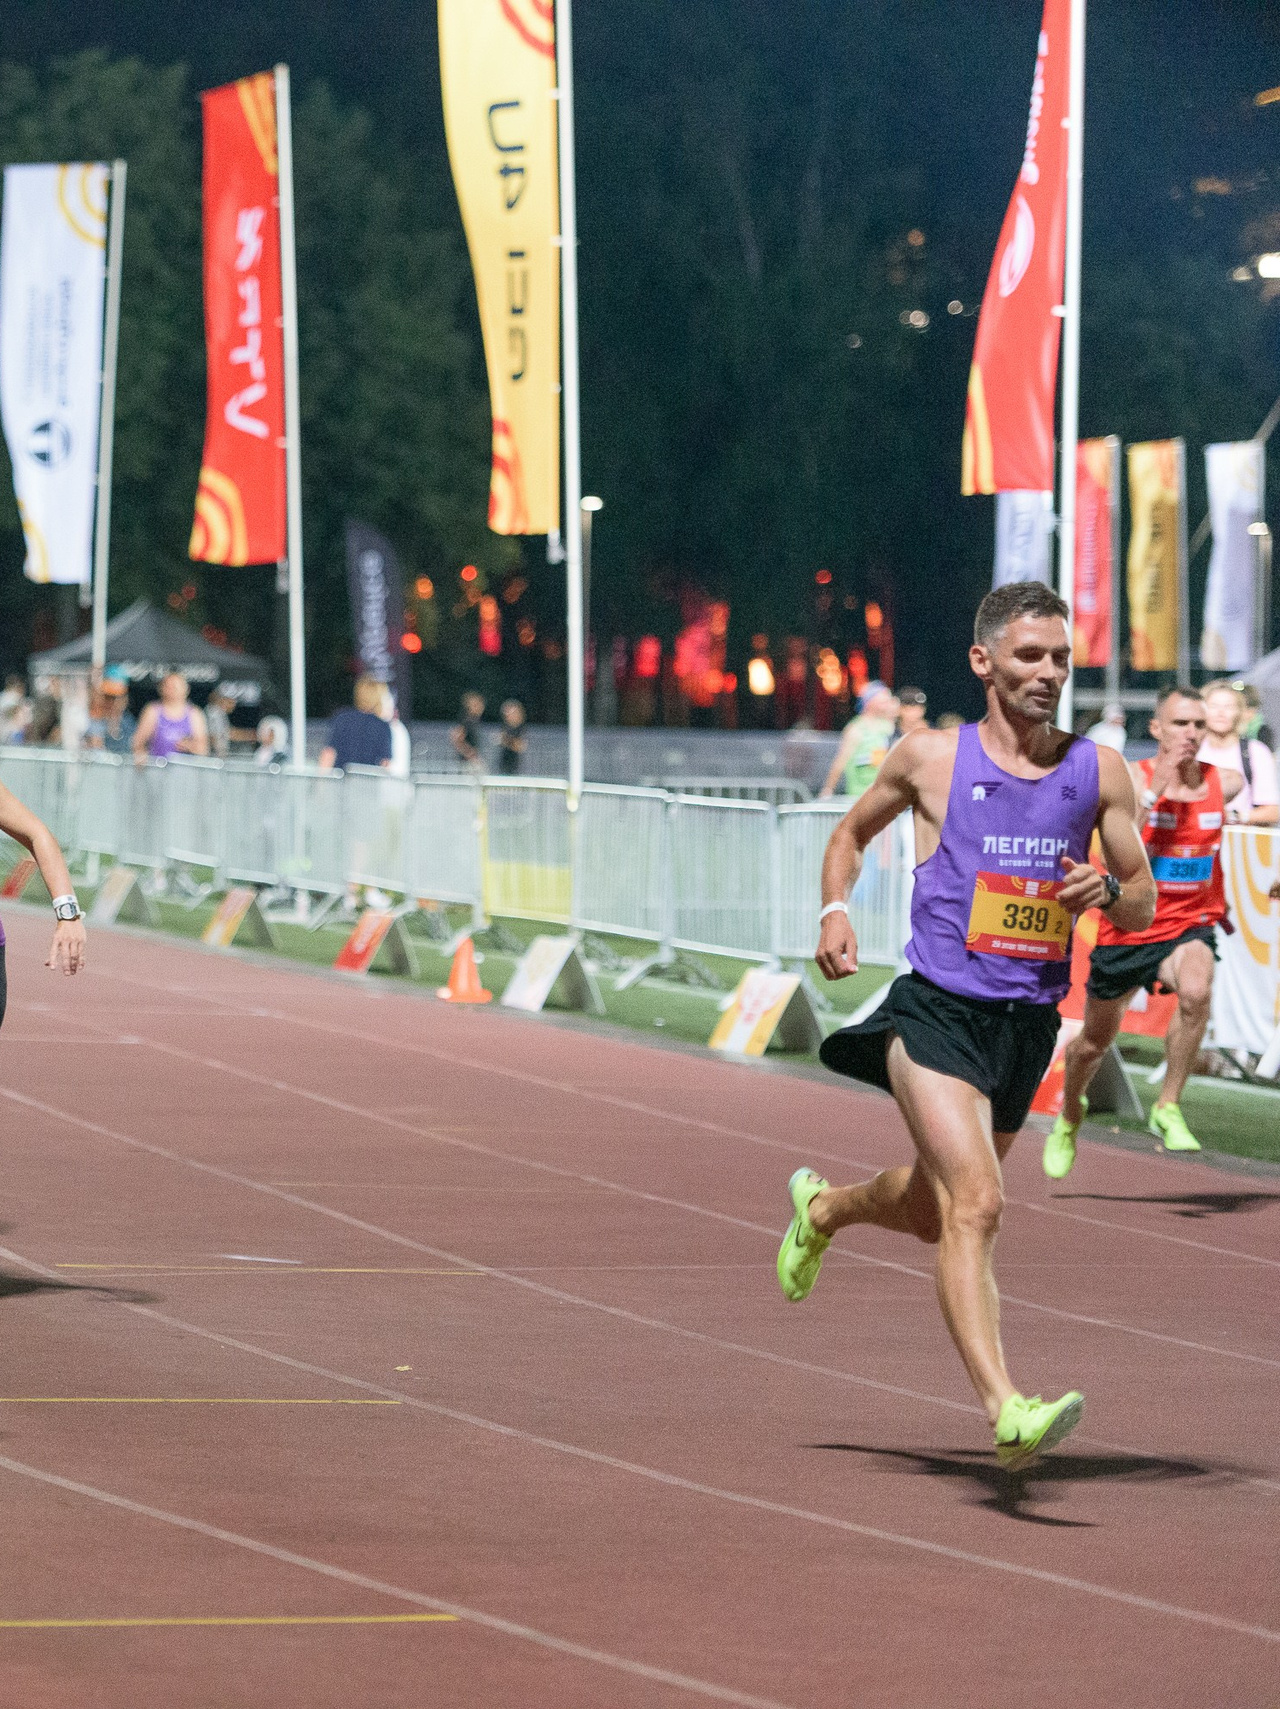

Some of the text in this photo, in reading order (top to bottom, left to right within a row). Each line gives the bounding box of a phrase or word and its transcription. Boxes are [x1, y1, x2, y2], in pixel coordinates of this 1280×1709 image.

[982, 836, 1069, 857] ЛЕГИОН
[1002, 903, 1063, 933] 339 2
